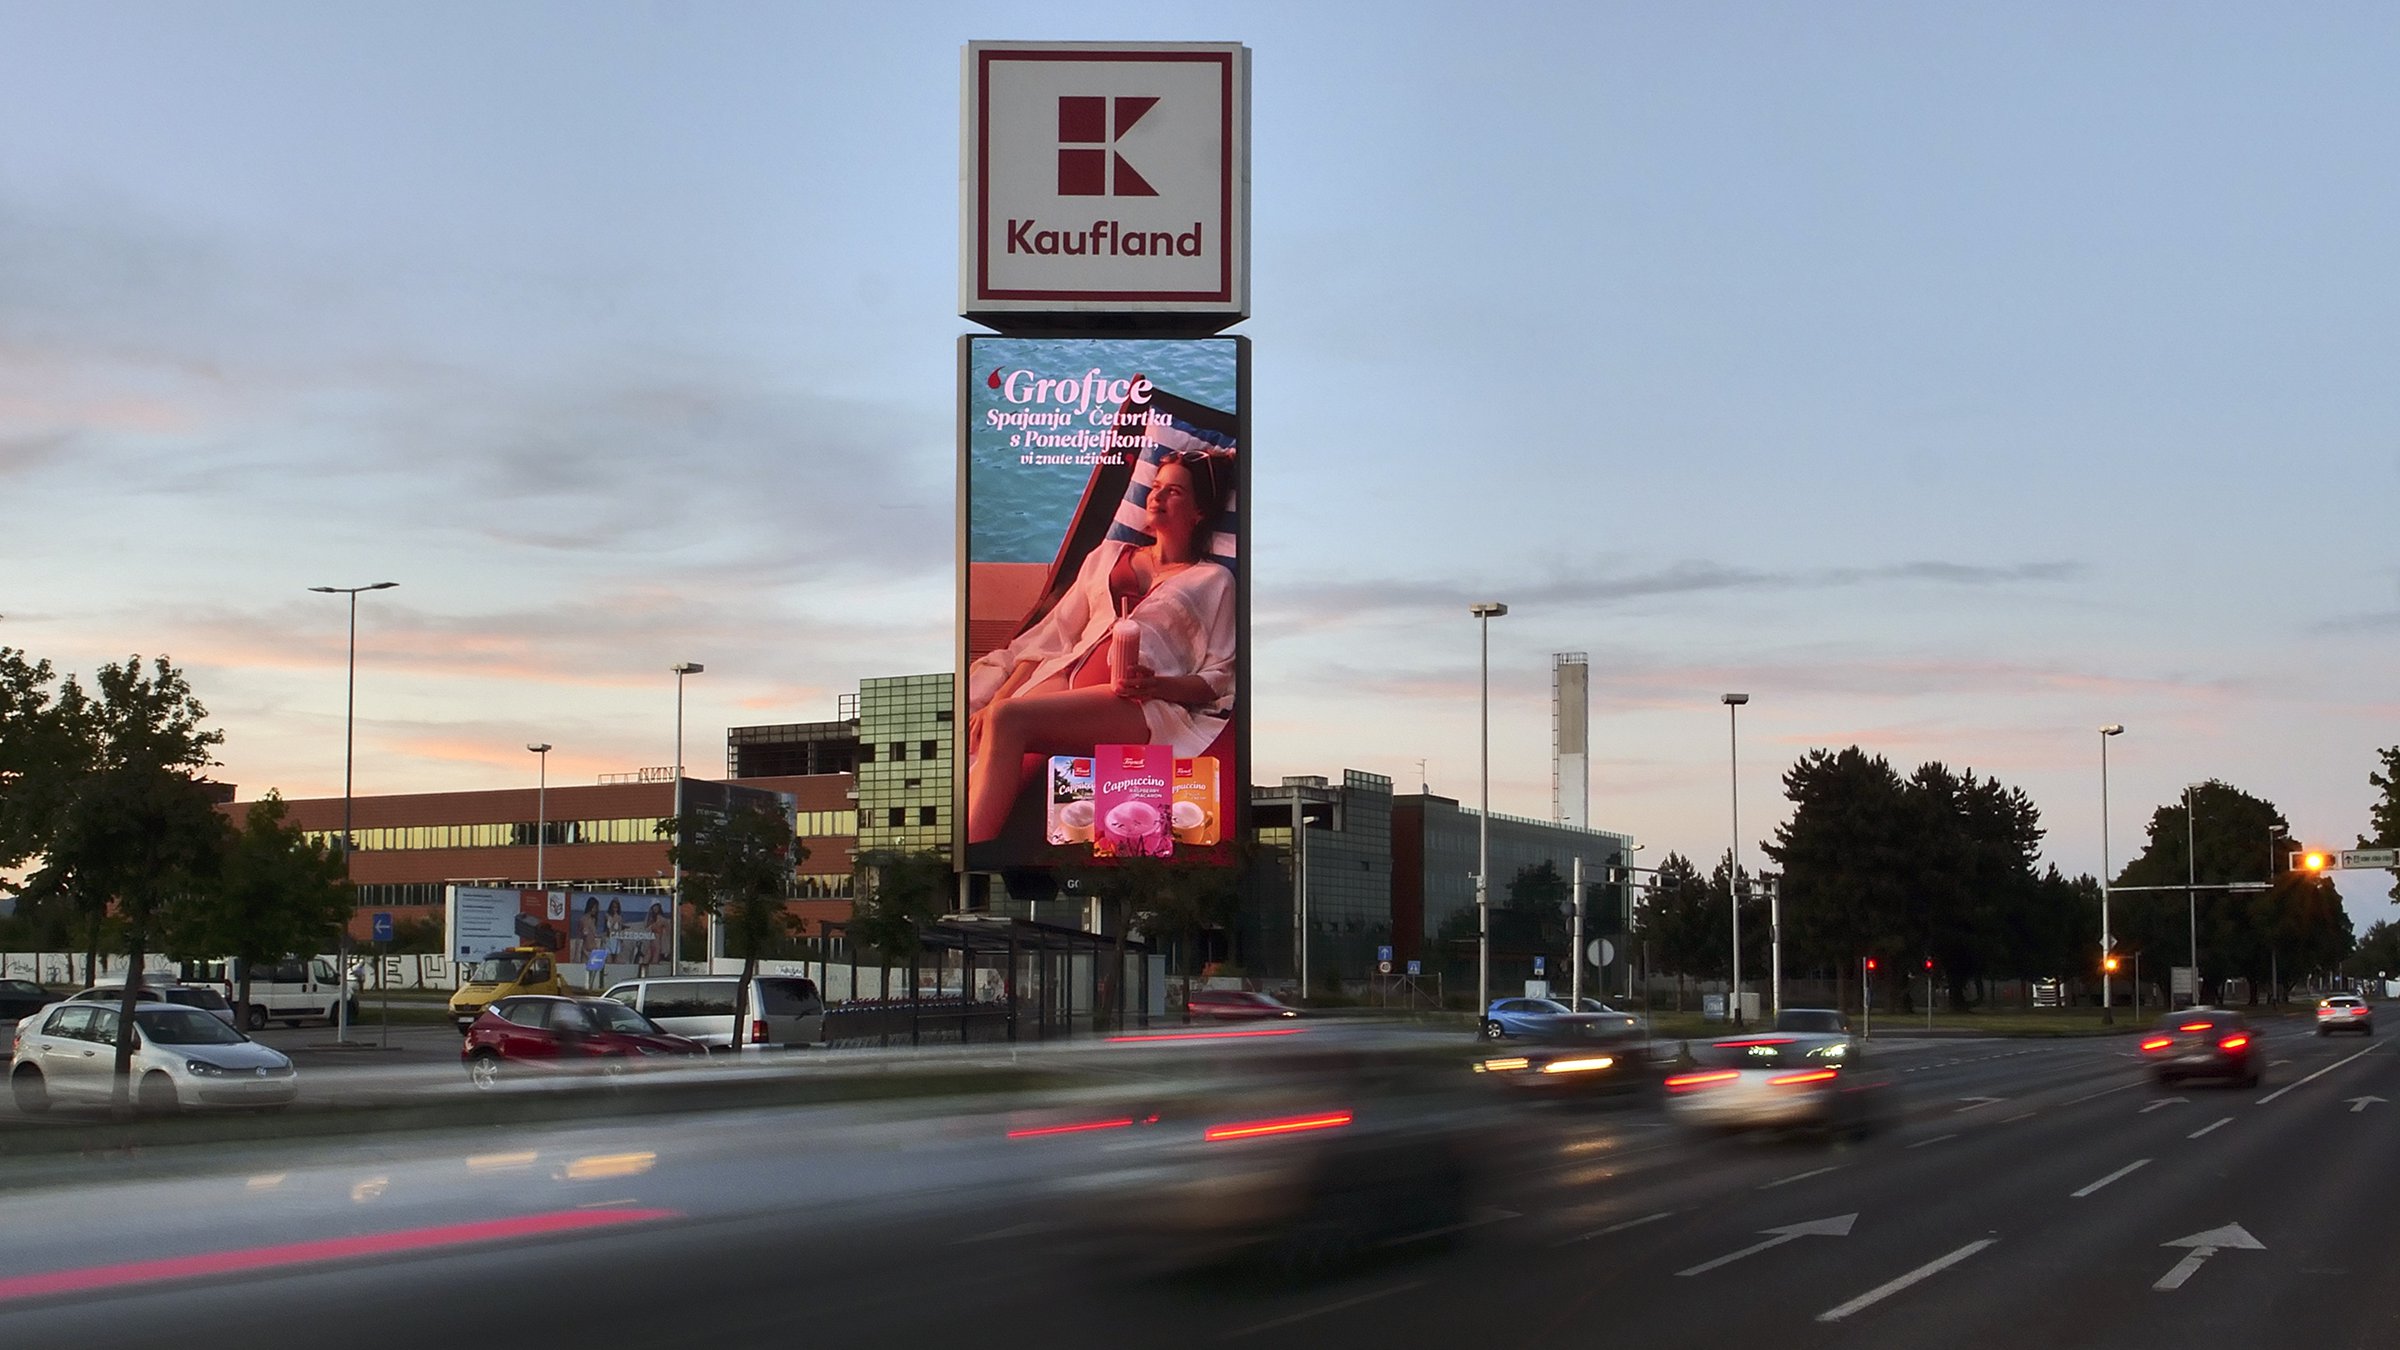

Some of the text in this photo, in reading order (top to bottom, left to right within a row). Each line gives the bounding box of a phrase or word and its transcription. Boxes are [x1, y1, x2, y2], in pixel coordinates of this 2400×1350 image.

[1007, 219, 1202, 257] Kaufland
[986, 404, 1173, 431] Spajanja Četvrtka
[1009, 430, 1159, 453] s Ponedjeljkom,
[1020, 452, 1034, 465] vi
[1035, 455, 1072, 465] znate
[1102, 774, 1165, 795] Cappuccino
